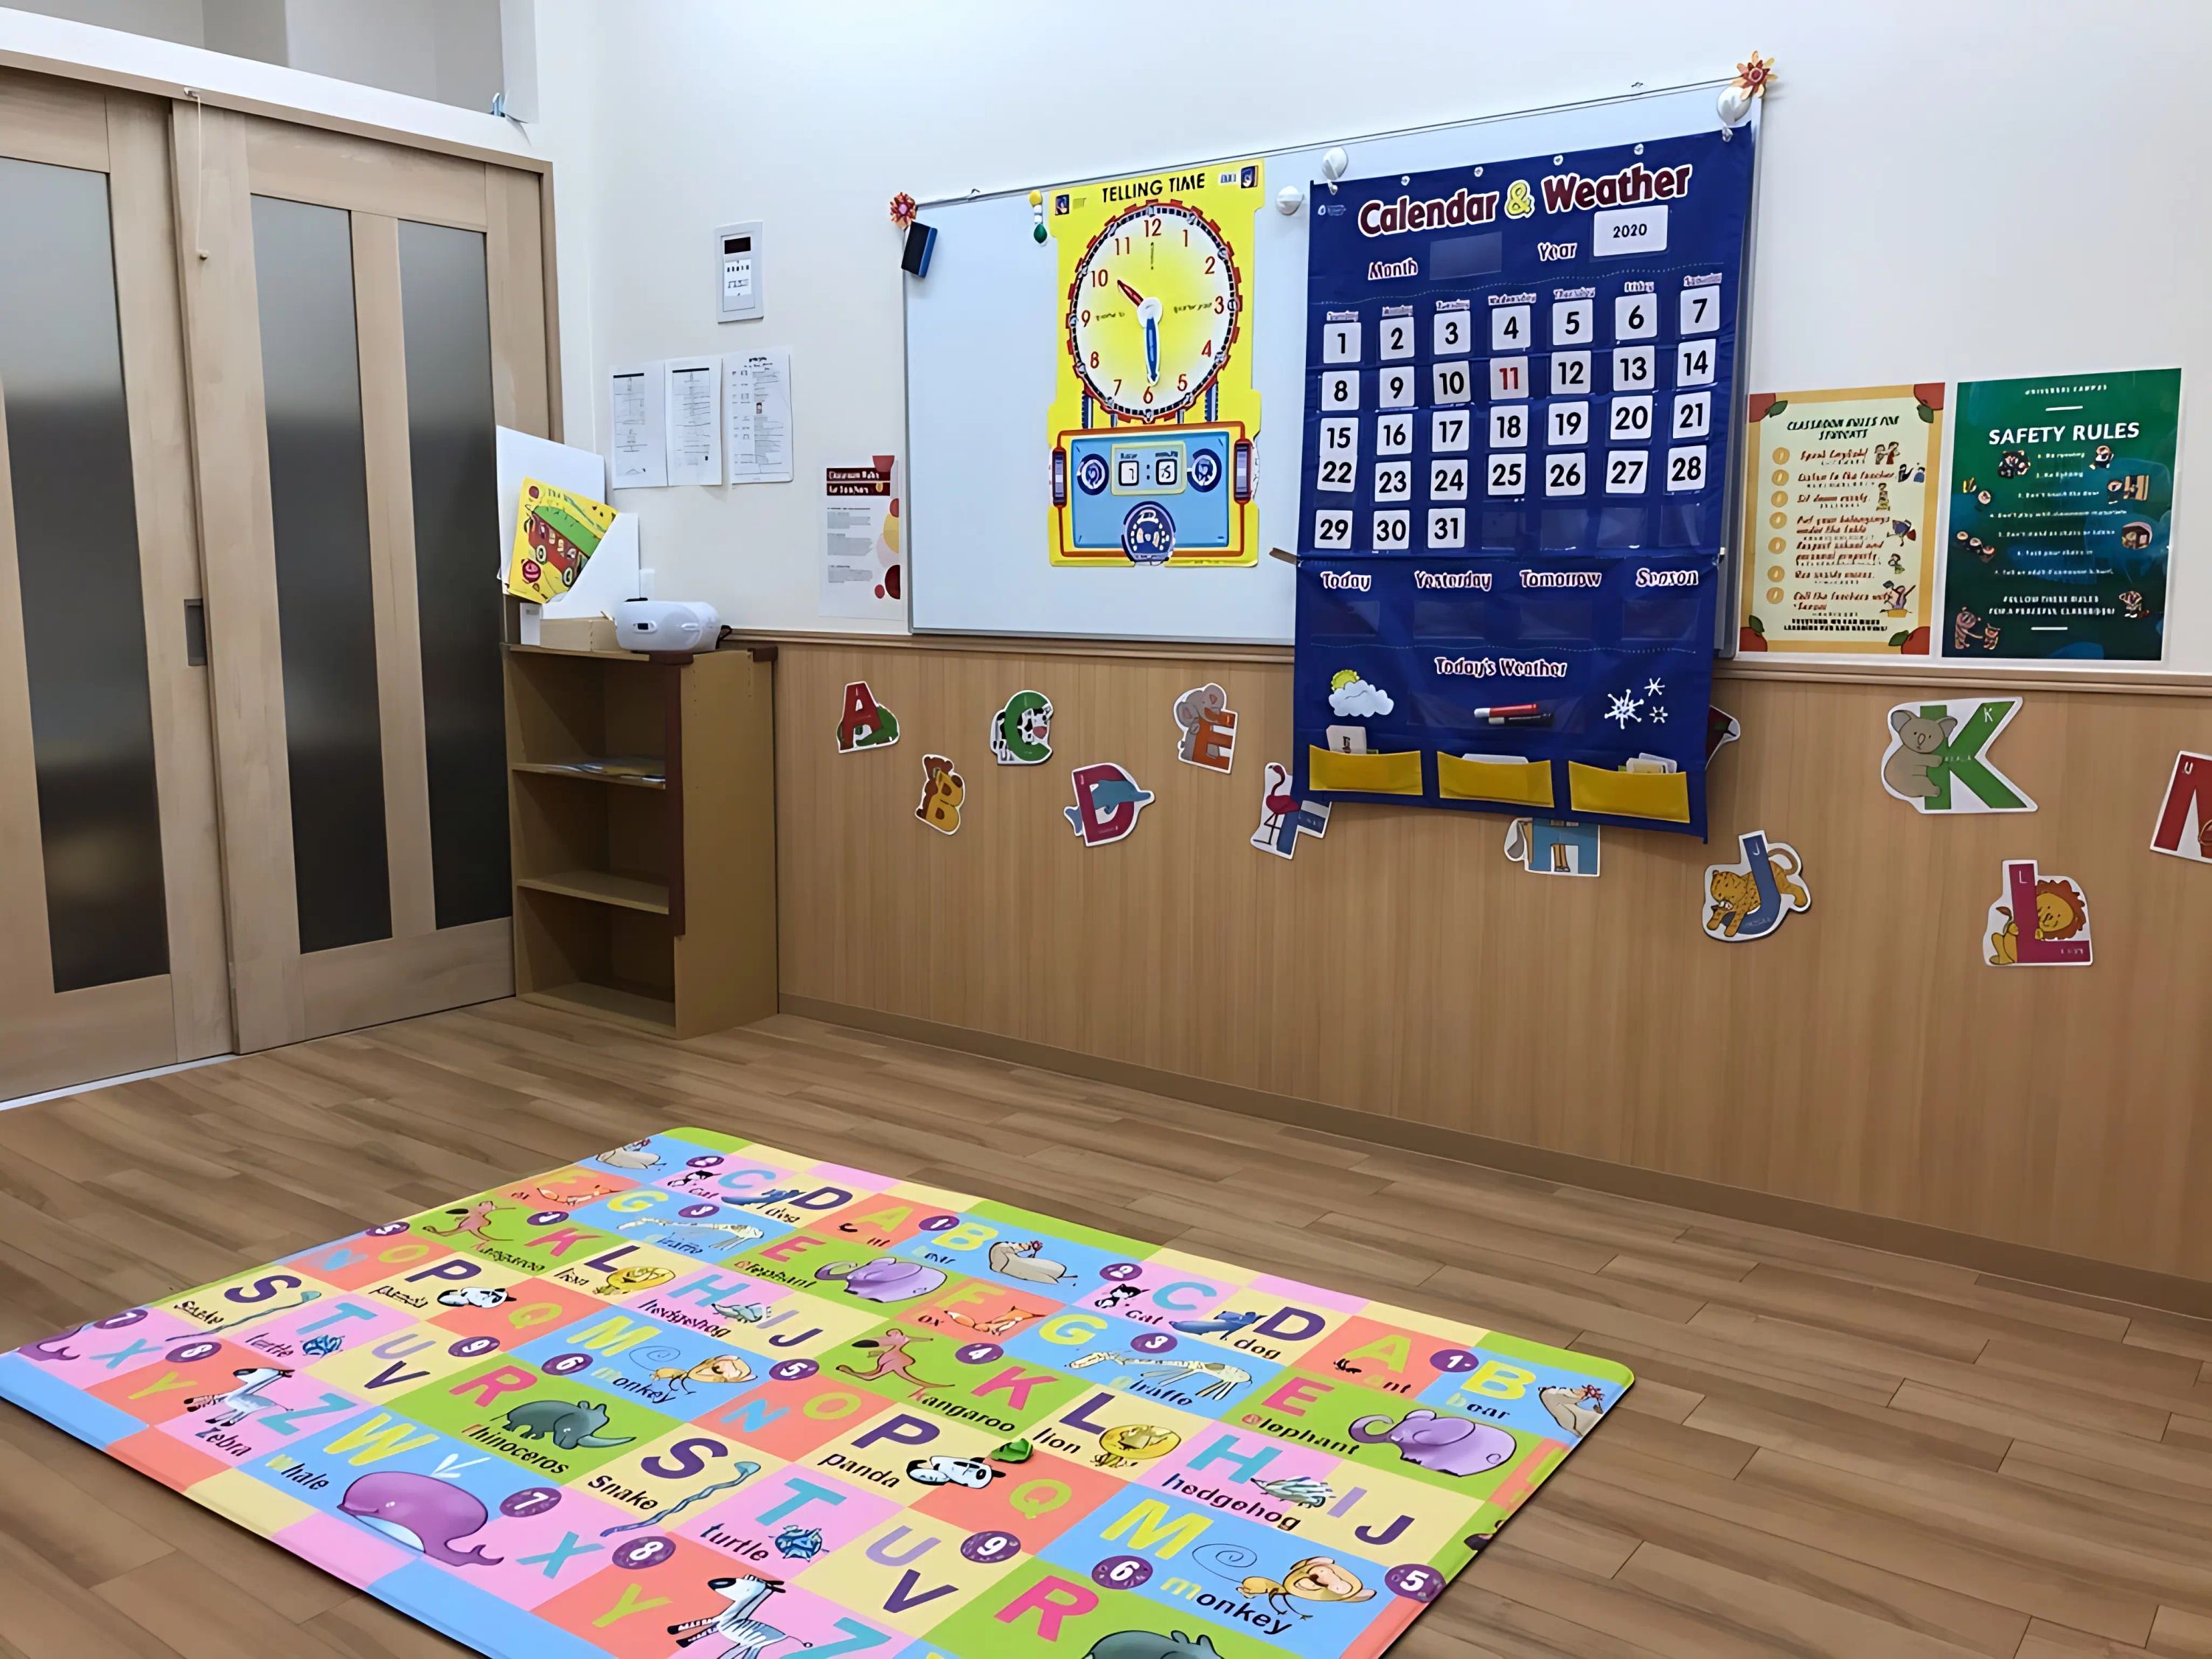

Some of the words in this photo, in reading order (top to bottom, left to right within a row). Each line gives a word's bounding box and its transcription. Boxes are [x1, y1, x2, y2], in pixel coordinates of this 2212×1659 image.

[1102, 180, 1163, 202] TELLING
[1169, 173, 1205, 192] TIME
[1360, 189, 1498, 235] Calendar
[1506, 181, 1534, 216] &
[1544, 164, 1692, 212] Weather
[1144, 218, 1161, 237] 12
[1183, 229, 1188, 247] 1
[1613, 223, 1647, 238] 2020
[1115, 237, 1130, 255] 11
[1368, 259, 1418, 279] Month
[1538, 243, 1577, 260] Year
[1091, 269, 1108, 288] 10
[1206, 257, 1215, 274] 2
[1081, 310, 1091, 327] 9
[1214, 296, 1224, 314] 3
[1338, 333, 1346, 353] 1
[1391, 327, 1403, 349] 2
[1445, 322, 1458, 344] 3
[1504, 316, 1519, 339] 4
[1565, 311, 1579, 335] 5
[1629, 305, 1644, 329] 6
[1693, 299, 1707, 323] 7
[1091, 351, 1099, 369] 8
[1201, 340, 1211, 357] 4
[1113, 379, 1122, 395] 7
[1177, 374, 1187, 392] 5
[1334, 380, 1348, 402] 8
[1390, 377, 1403, 399] 9
[1439, 372, 1464, 394] 10
[1499, 367, 1518, 390] 11
[1558, 361, 1584, 384] 12
[1620, 357, 1646, 381] 13
[1683, 350, 1708, 376] 14
[1143, 386, 1153, 404] 6
[1327, 427, 1351, 448] 15
[1383, 423, 1405, 446] 16
[1439, 420, 1463, 442] 17
[1497, 415, 1520, 439] 18
[1555, 412, 1581, 436] 19
[1615, 406, 1648, 430] 20
[1680, 403, 1703, 428] 21
[1989, 425, 2065, 445] SAFETY
[2073, 422, 2139, 441] RULES
[1322, 461, 1352, 483] 22
[1379, 470, 1406, 493] 23
[1434, 468, 1464, 491] 24
[1492, 463, 1521, 486] 25
[1550, 463, 1580, 487] 26
[1611, 461, 1644, 484] 27
[1672, 456, 1701, 481] 28
[1319, 519, 1348, 540] 29
[1377, 519, 1406, 541] 30
[1434, 518, 1458, 540] 31
[1321, 571, 1371, 591] Today
[1414, 571, 1492, 591] Yesterday
[1520, 570, 1601, 588] Tomorrow
[1435, 657, 1495, 678] Today's
[1500, 658, 1568, 678] Weather
[840, 683, 882, 750] A
[1005, 692, 1052, 761] C
[1180, 708, 1234, 770] E
[1919, 701, 2027, 809] K
[925, 770, 964, 832] B
[1073, 765, 1135, 843] D
[1721, 835, 1781, 934] J
[2020, 870, 2028, 883] L
[2008, 863, 2090, 963] L
[718, 1169, 776, 1189] C
[607, 1191, 668, 1213] G
[792, 1186, 852, 1210] D
[852, 1206, 914, 1232] A
[524, 1228, 602, 1257] K
[759, 1236, 827, 1262] E
[931, 1222, 998, 1251] B
[378, 1245, 430, 1263] O
[585, 1245, 641, 1273] L
[405, 1259, 481, 1283] P
[224, 1275, 302, 1303] S
[667, 1274, 751, 1307] H
[1152, 1281, 1217, 1311] C
[296, 1302, 378, 1335] T
[508, 1302, 563, 1329] Q
[1039, 1314, 1107, 1345] G
[1253, 1307, 1326, 1341] D
[371, 1334, 436, 1360] U
[566, 1315, 662, 1357] M
[769, 1328, 823, 1348] J
[1234, 1338, 1281, 1360] dog
[90, 1338, 164, 1369] X
[1354, 1334, 1411, 1373] A
[128, 1371, 198, 1399] Y
[364, 1360, 430, 1389] V
[448, 1365, 537, 1408] R
[971, 1366, 1059, 1411] K
[1461, 1360, 1537, 1399] B
[803, 1391, 862, 1420] O
[1262, 1377, 1334, 1416] E
[257, 1393, 358, 1435] Z
[720, 1398, 790, 1433] N
[1059, 1392, 1116, 1435] L
[195, 1427, 252, 1458] zebra
[323, 1412, 439, 1467] W
[851, 1413, 941, 1449] P
[1033, 1427, 1081, 1455] lion
[641, 1438, 728, 1479] S
[817, 1453, 900, 1489] panda
[1186, 1434, 1282, 1485] H
[514, 1492, 549, 1511] 7
[755, 1478, 847, 1526] T
[1009, 1478, 1072, 1519] Q
[1327, 1486, 1366, 1518] I
[1100, 1498, 1214, 1559] M
[1354, 1514, 1415, 1545] J
[515, 1531, 605, 1579] X
[630, 1542, 664, 1560] 8
[866, 1525, 942, 1567] U
[976, 1537, 1008, 1556] 9
[1110, 1561, 1140, 1579] 6
[1400, 1570, 1430, 1590] 5
[592, 1583, 672, 1627] Y
[883, 1569, 959, 1613] V
[1160, 1577, 1292, 1635] monkey
[994, 1575, 1099, 1642] R
